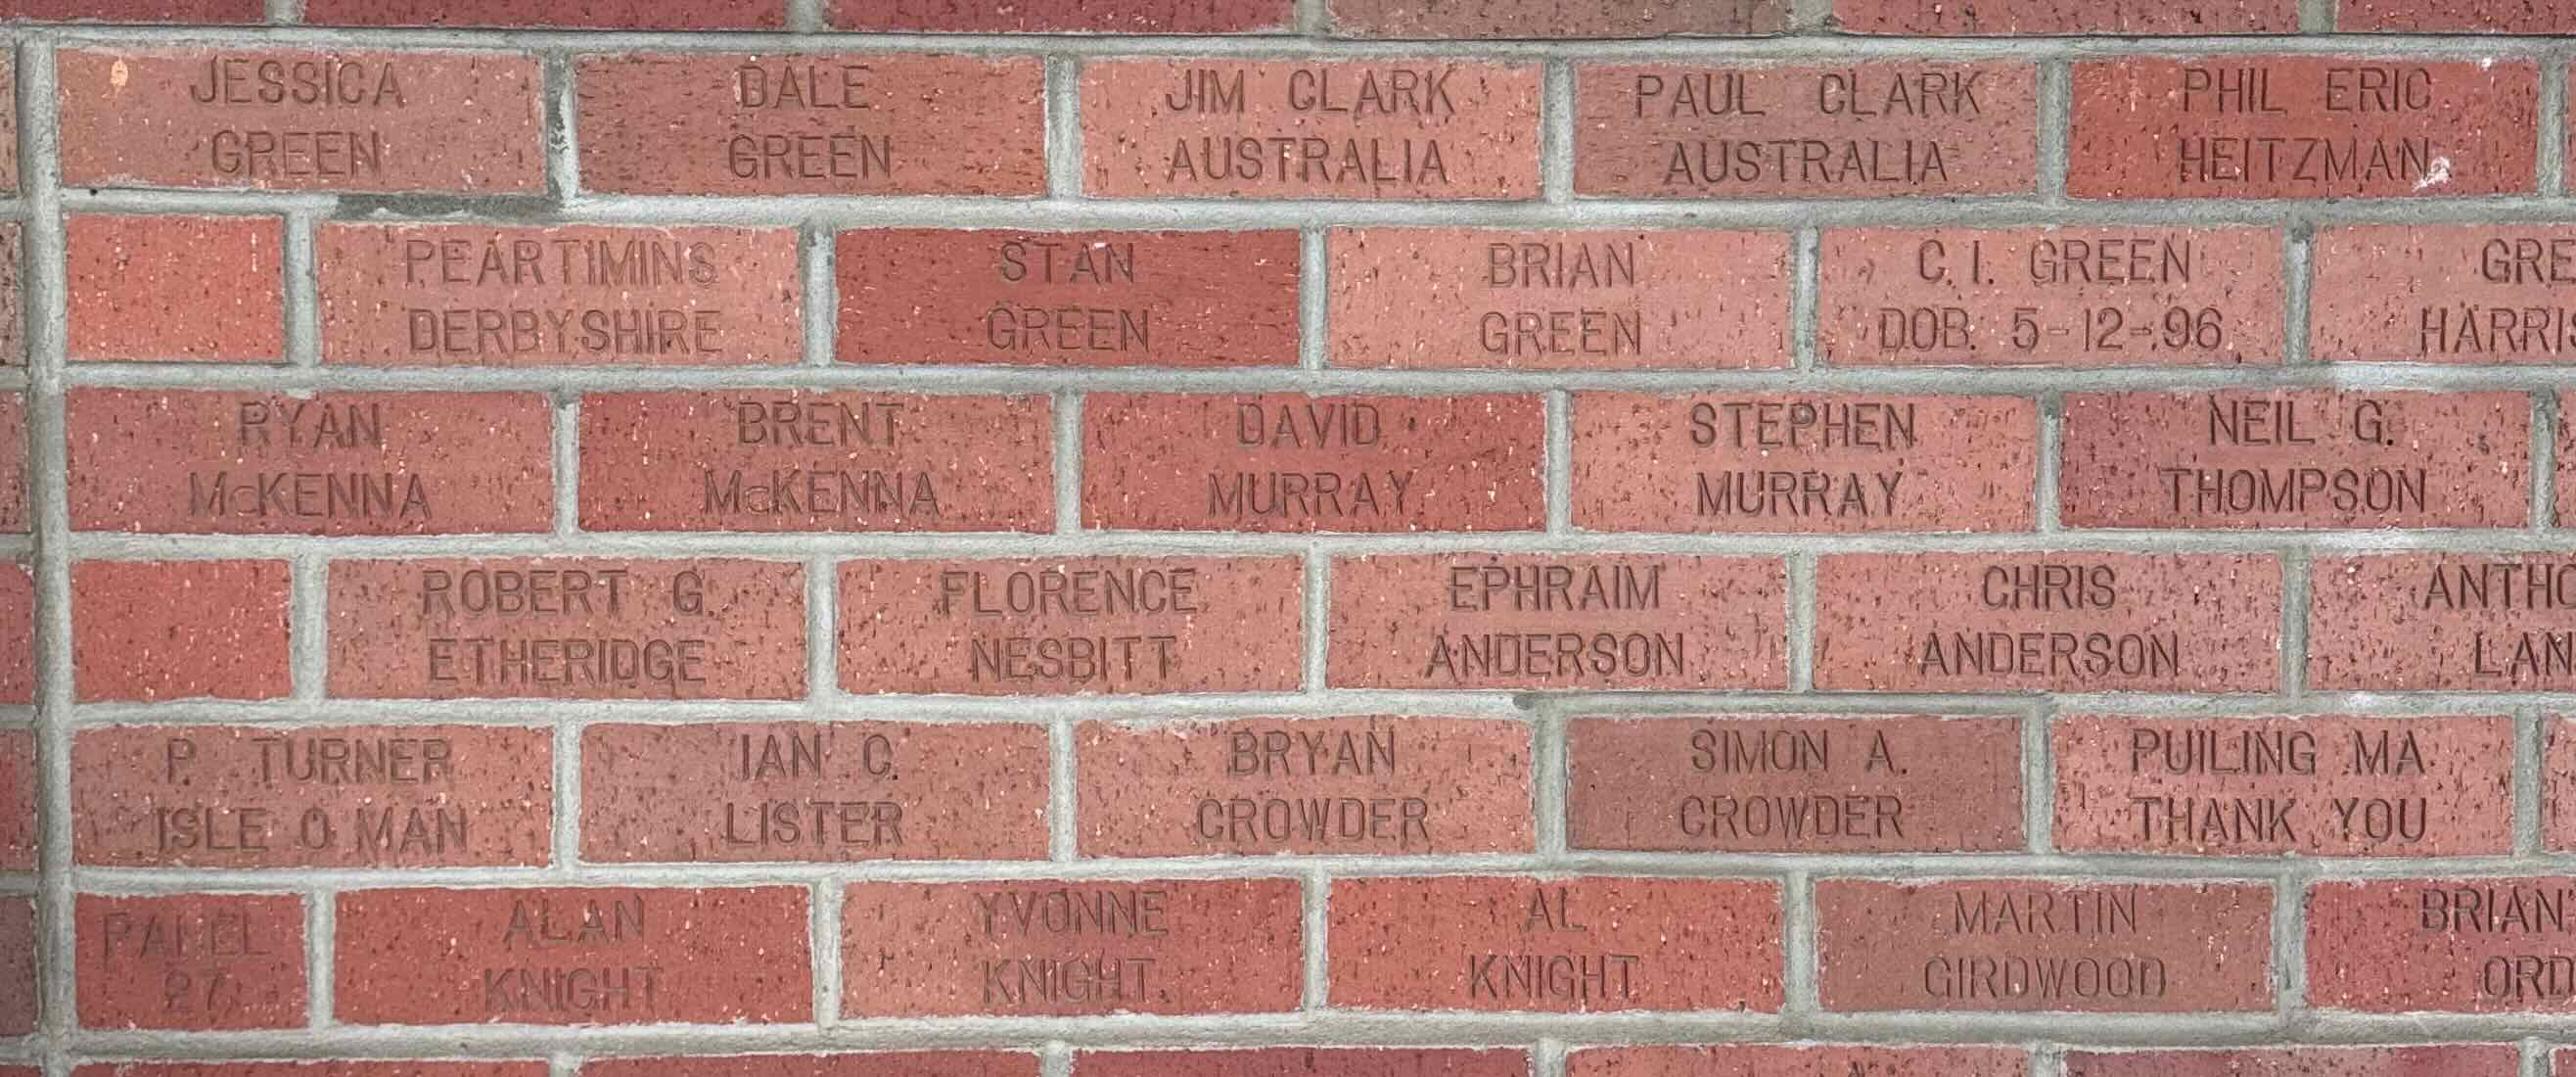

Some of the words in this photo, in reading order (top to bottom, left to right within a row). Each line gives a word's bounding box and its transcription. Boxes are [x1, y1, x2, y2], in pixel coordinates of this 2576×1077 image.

[190, 59, 406, 109] JESSICA
[739, 65, 870, 111] DALE
[1166, 69, 1246, 115] JIM
[1289, 69, 1456, 116] CLARK
[1635, 70, 1766, 117] PAUL
[1818, 70, 1983, 117] CLARK
[2184, 68, 2287, 113] PHIL
[2325, 68, 2432, 113] ERIC
[210, 130, 383, 178] GREEN
[728, 134, 890, 180] GREEN
[1167, 136, 1449, 184] AUSTRALIA
[1665, 139, 1950, 187] AUSTRALIA
[2179, 137, 2430, 183] HEITZMAN
[1000, 241, 1135, 284] STAN
[1489, 241, 1635, 290] BRIAN
[2030, 239, 2191, 285] GREEN
[407, 309, 722, 354] DERBYSHIRE
[987, 308, 1150, 353] GREEN
[1480, 309, 1641, 357] GREEN
[238, 401, 383, 448] RYAN
[737, 401, 904, 446] BRENT
[1237, 402, 1381, 448] DAVID
[1691, 402, 1915, 450] STEPHEN
[2208, 399, 2316, 445] NEIL
[2354, 399, 2394, 446] G.
[189, 471, 433, 518] McKENNA
[704, 470, 941, 517] McKENNA
[1207, 471, 1413, 518] MURRAY
[1698, 470, 1902, 517] MURRAY
[2161, 468, 2427, 514] THOMPSON
[423, 569, 627, 617] ROBERT
[941, 567, 1197, 616] FLORENCE
[1449, 565, 1661, 612] EPHRAIM
[1981, 564, 2116, 611] CHRIS
[428, 638, 707, 684] ETHERIDGE
[970, 634, 1176, 682] NESBITT
[1426, 632, 1684, 679] ANDERSON
[1920, 632, 2181, 678] ANDERSON
[252, 738, 455, 786] TURNER
[741, 733, 822, 779] IAN
[863, 733, 898, 780] C.
[1229, 729, 1397, 777] BRYAN
[1691, 728, 1828, 773] SIMON
[1863, 729, 1909, 774] A.
[2130, 729, 2317, 775] PUILING
[2354, 729, 2426, 775] MA
[157, 808, 269, 853] ISLE
[299, 807, 331, 851] O
[354, 807, 468, 854] MAN
[726, 801, 904, 847] LISTER
[1196, 796, 1431, 843] CROWDER
[1679, 795, 1905, 839] CROWDER
[2128, 796, 2297, 843] THANK
[2332, 796, 2427, 843] YOU
[502, 896, 645, 945] ALAN
[974, 889, 1169, 937] YVONNE
[1523, 888, 1587, 933] AL
[1954, 889, 2138, 936] MARTIN
[484, 967, 663, 1013] KNIGHT
[981, 956, 1156, 1004] KNIGHT
[1468, 954, 1638, 1001] KNIGHT
[1924, 955, 2168, 1001] GIRDWOOD
